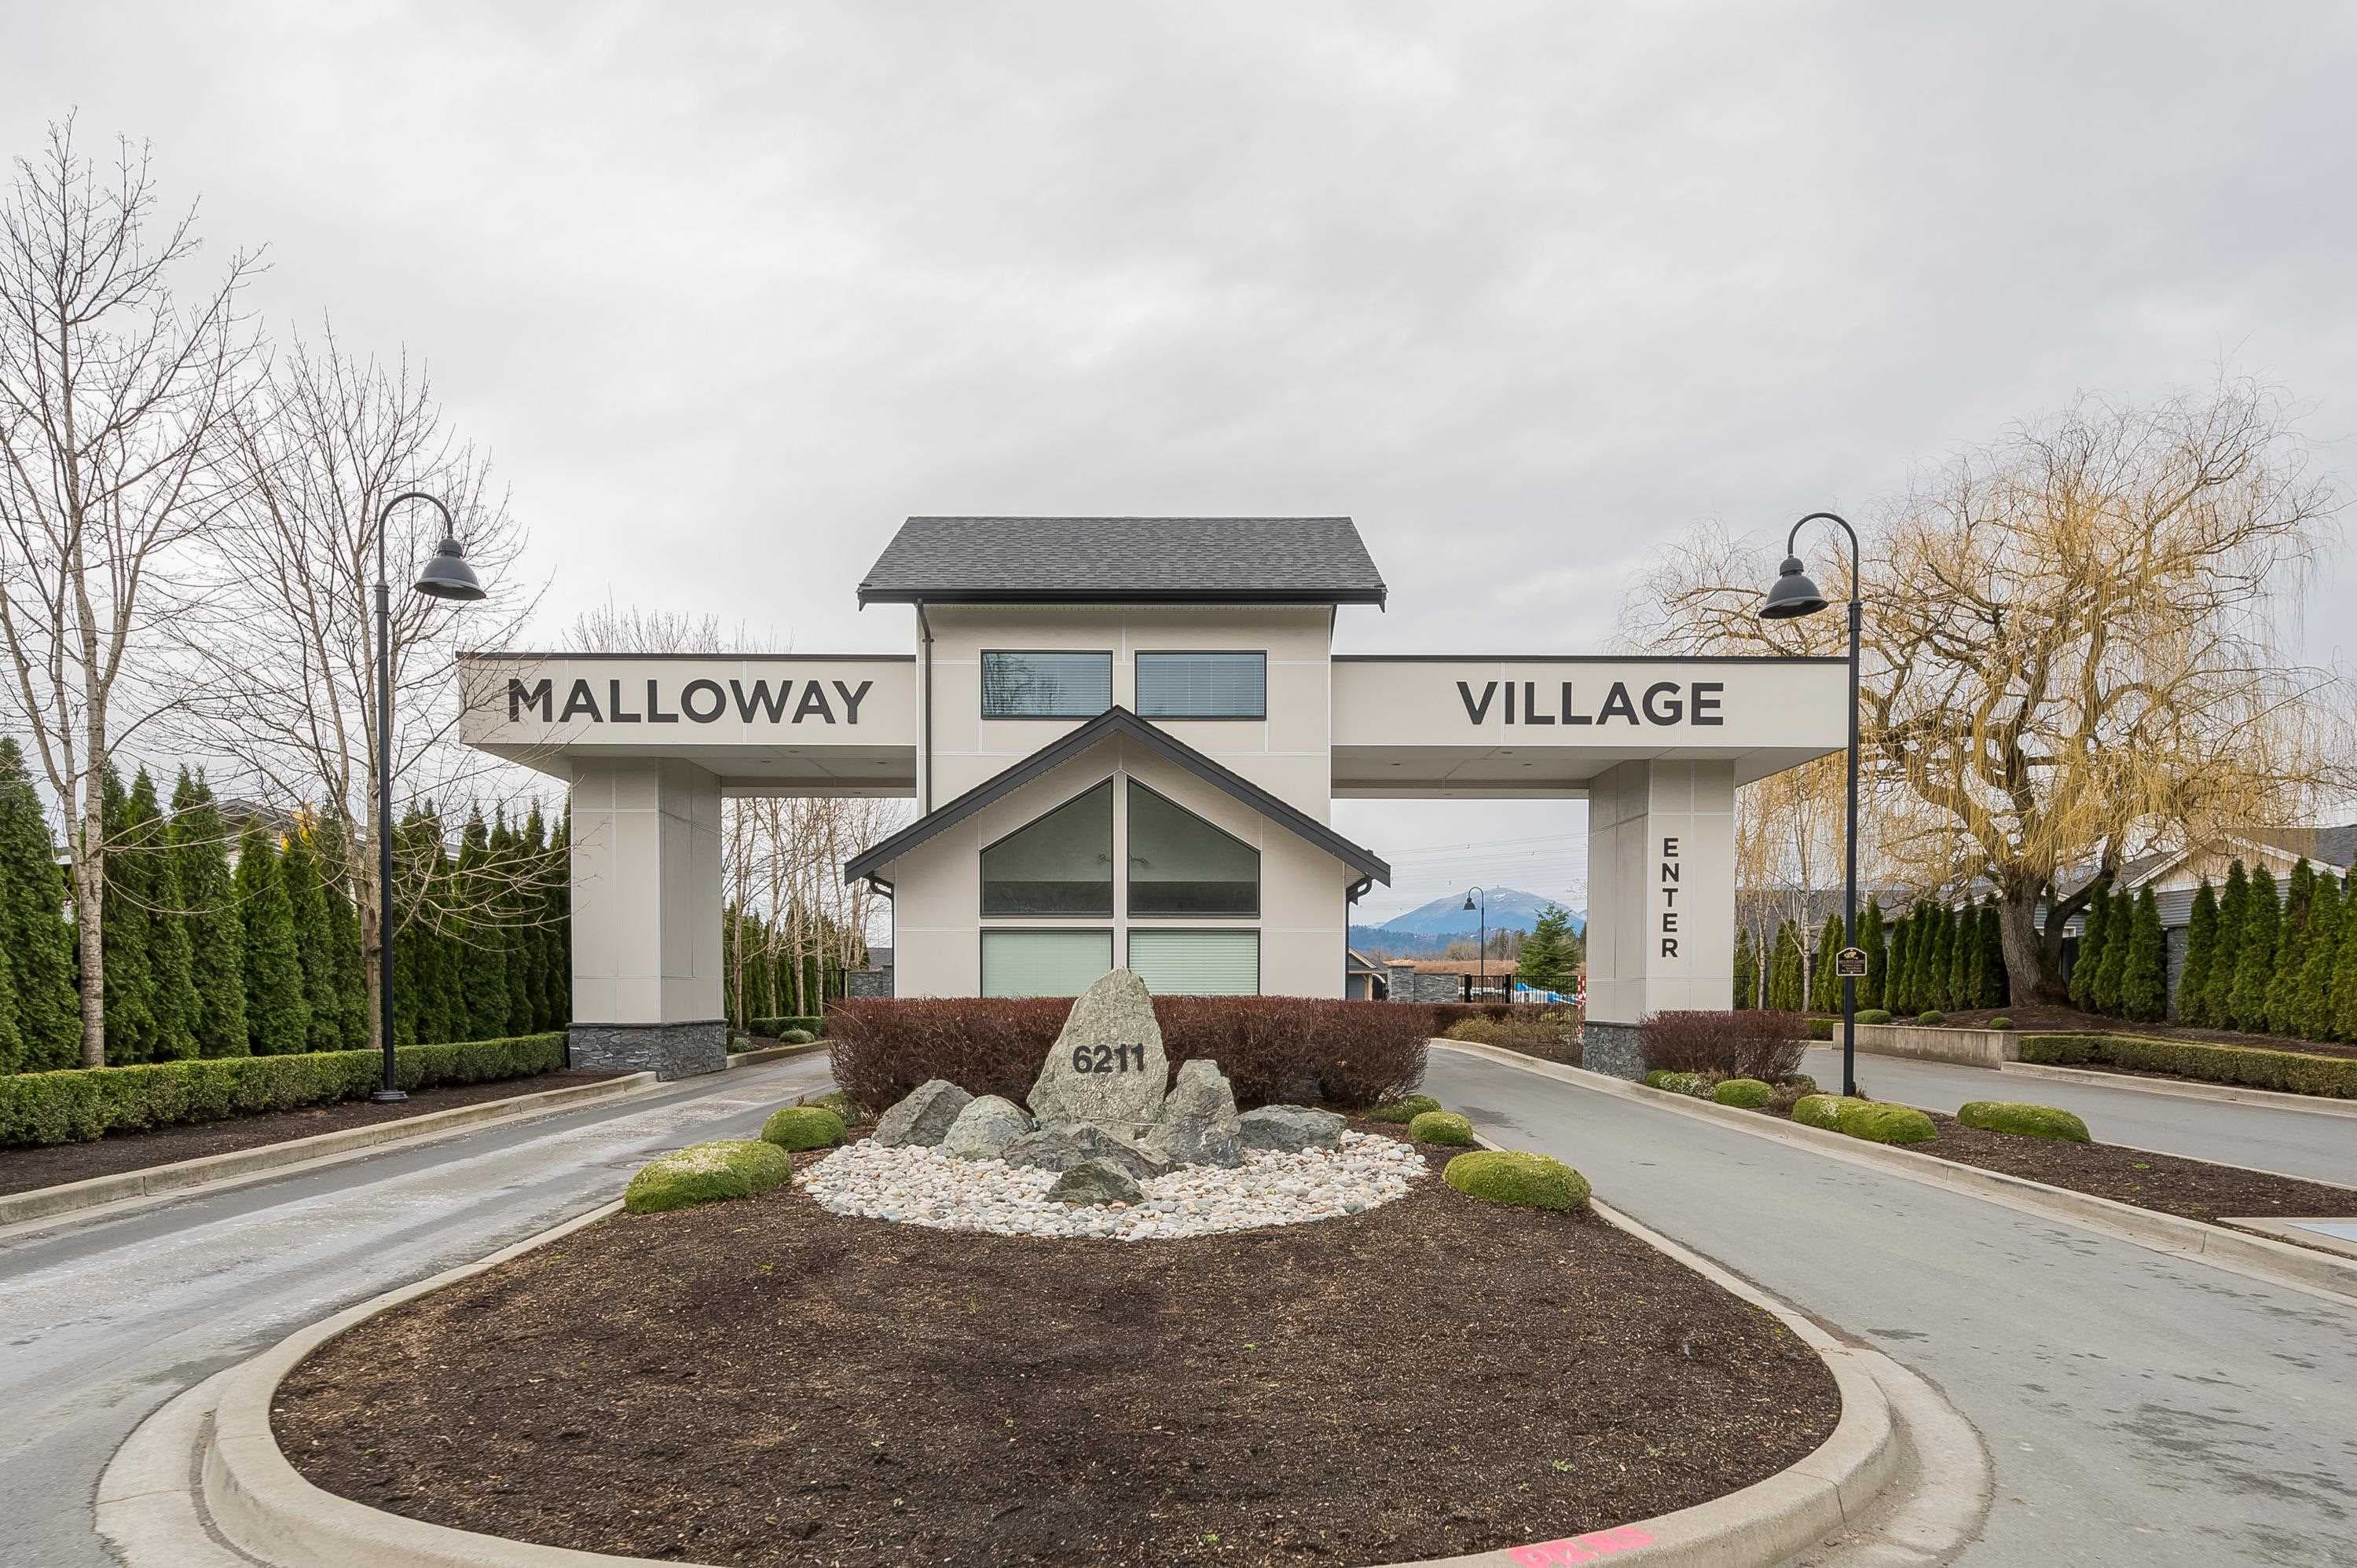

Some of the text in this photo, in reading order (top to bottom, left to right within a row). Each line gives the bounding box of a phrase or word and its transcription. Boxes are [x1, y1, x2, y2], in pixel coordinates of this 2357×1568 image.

[509, 679, 874, 724] MALLOWAY
[1457, 681, 1724, 726] VILLAGE
[1662, 837, 1680, 958] ENTER
[1073, 1042, 1145, 1074] 6211
